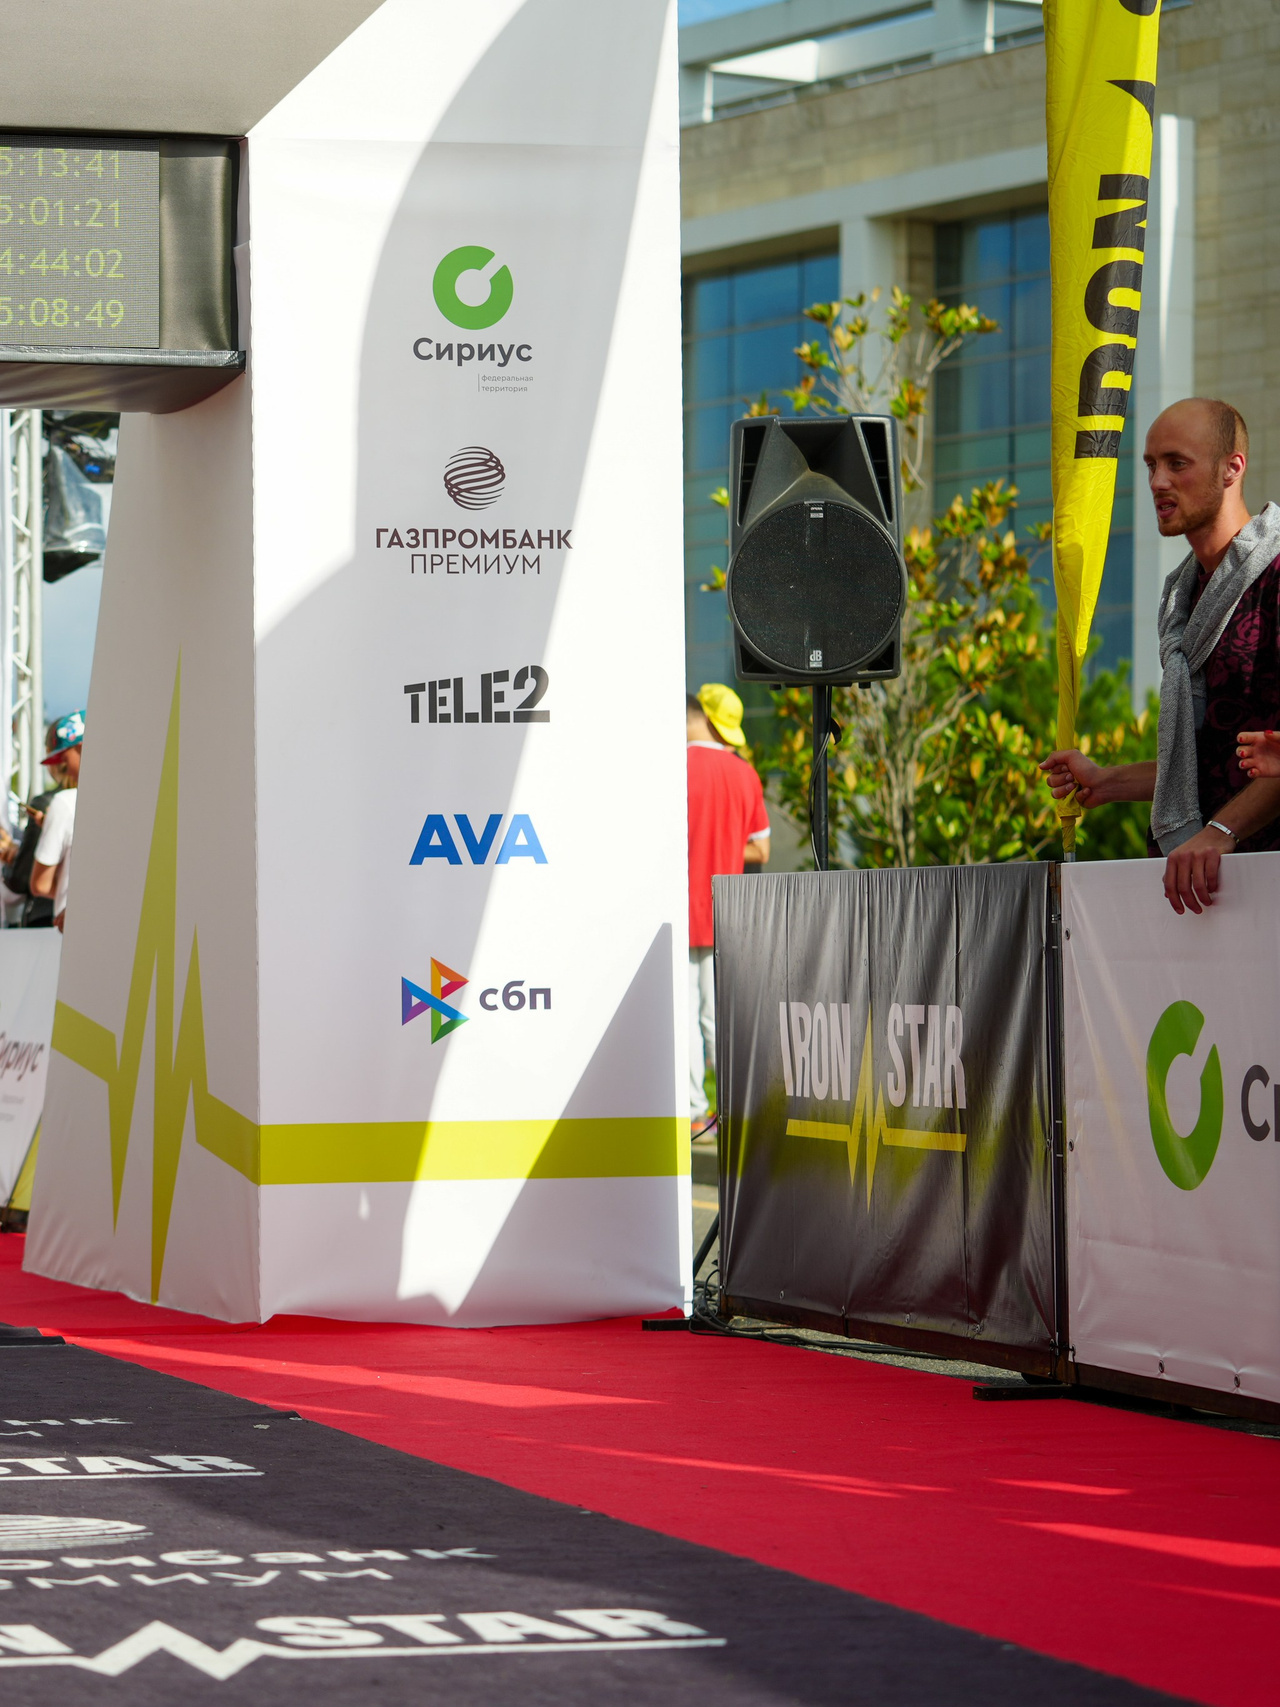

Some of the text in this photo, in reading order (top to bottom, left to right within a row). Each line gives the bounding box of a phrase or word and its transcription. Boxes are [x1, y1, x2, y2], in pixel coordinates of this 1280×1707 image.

[413, 337, 533, 368] Сириус
[481, 374, 534, 383] федеральная
[481, 385, 528, 393] территория
[376, 528, 573, 550] ГАЗПРОМБАНК
[411, 554, 541, 575] ПРЕМИУМ
[404, 665, 550, 723] TELE2
[409, 814, 549, 865] AVA
[479, 980, 551, 1011] сбп
[779, 1001, 967, 1110] IRON STAR
[256, 1608, 711, 1648] STAR
